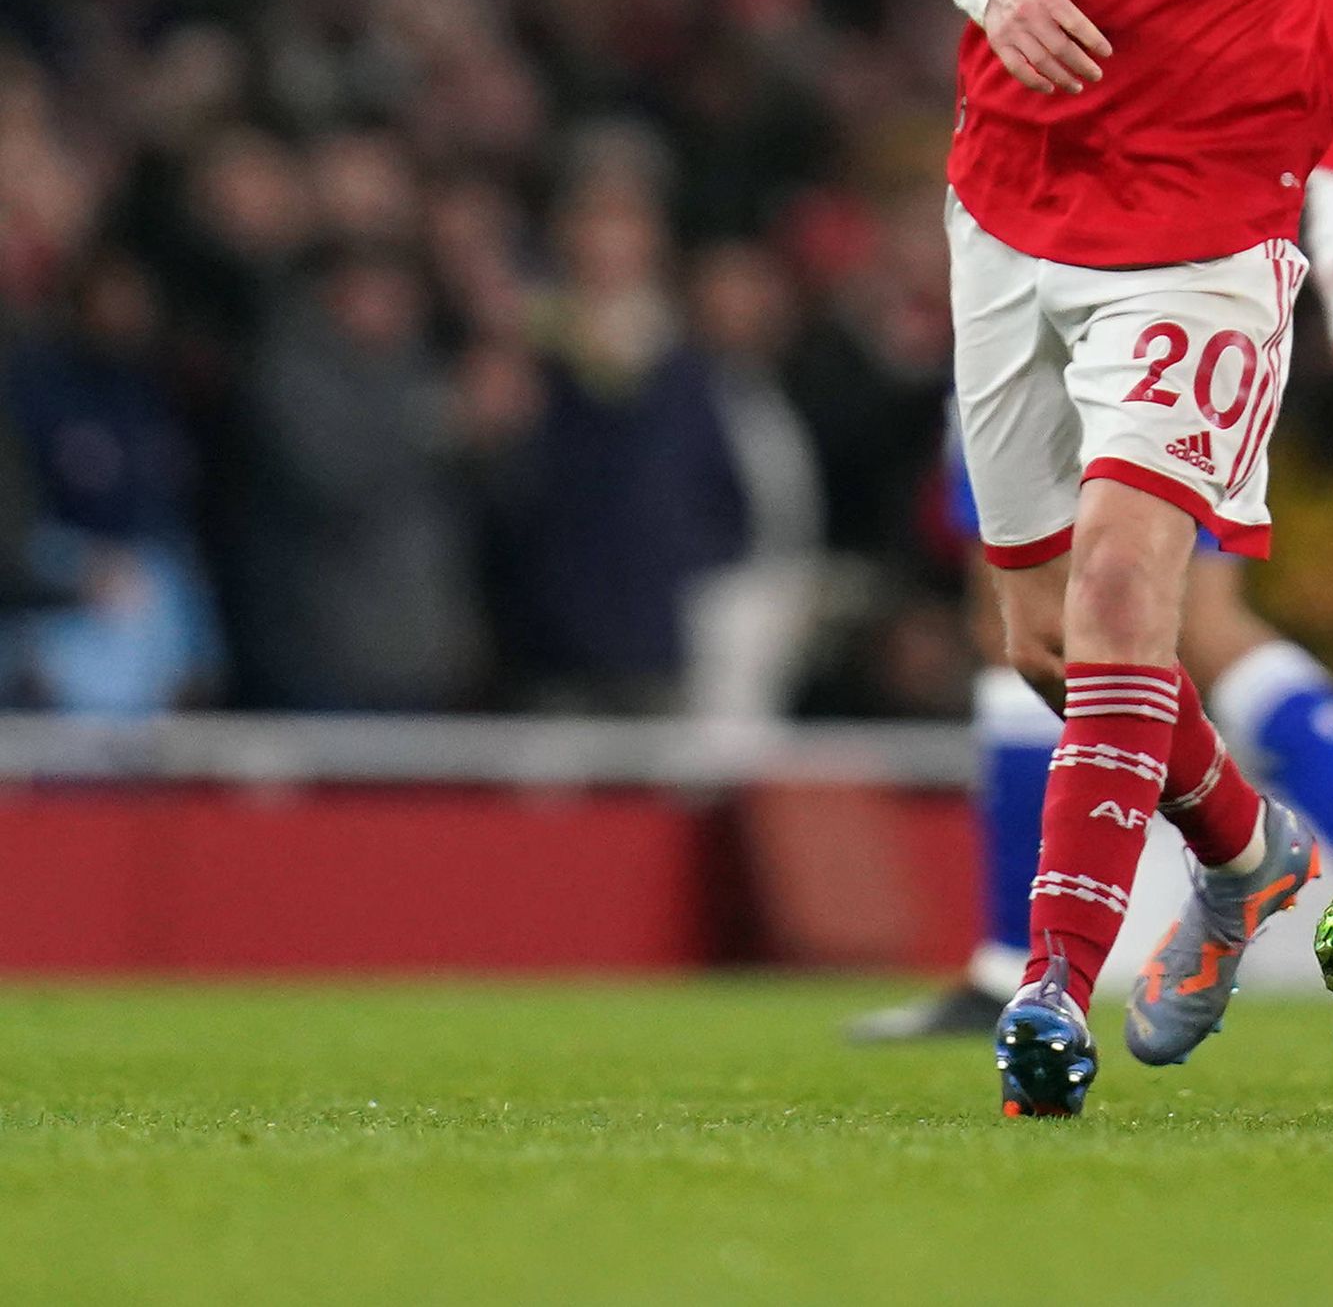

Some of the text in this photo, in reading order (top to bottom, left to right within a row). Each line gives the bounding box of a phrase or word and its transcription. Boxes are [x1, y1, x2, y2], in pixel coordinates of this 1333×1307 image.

[1121, 321, 1258, 430] 20
[1165, 443, 1216, 476] adidas
[1088, 800, 1151, 833] AF
